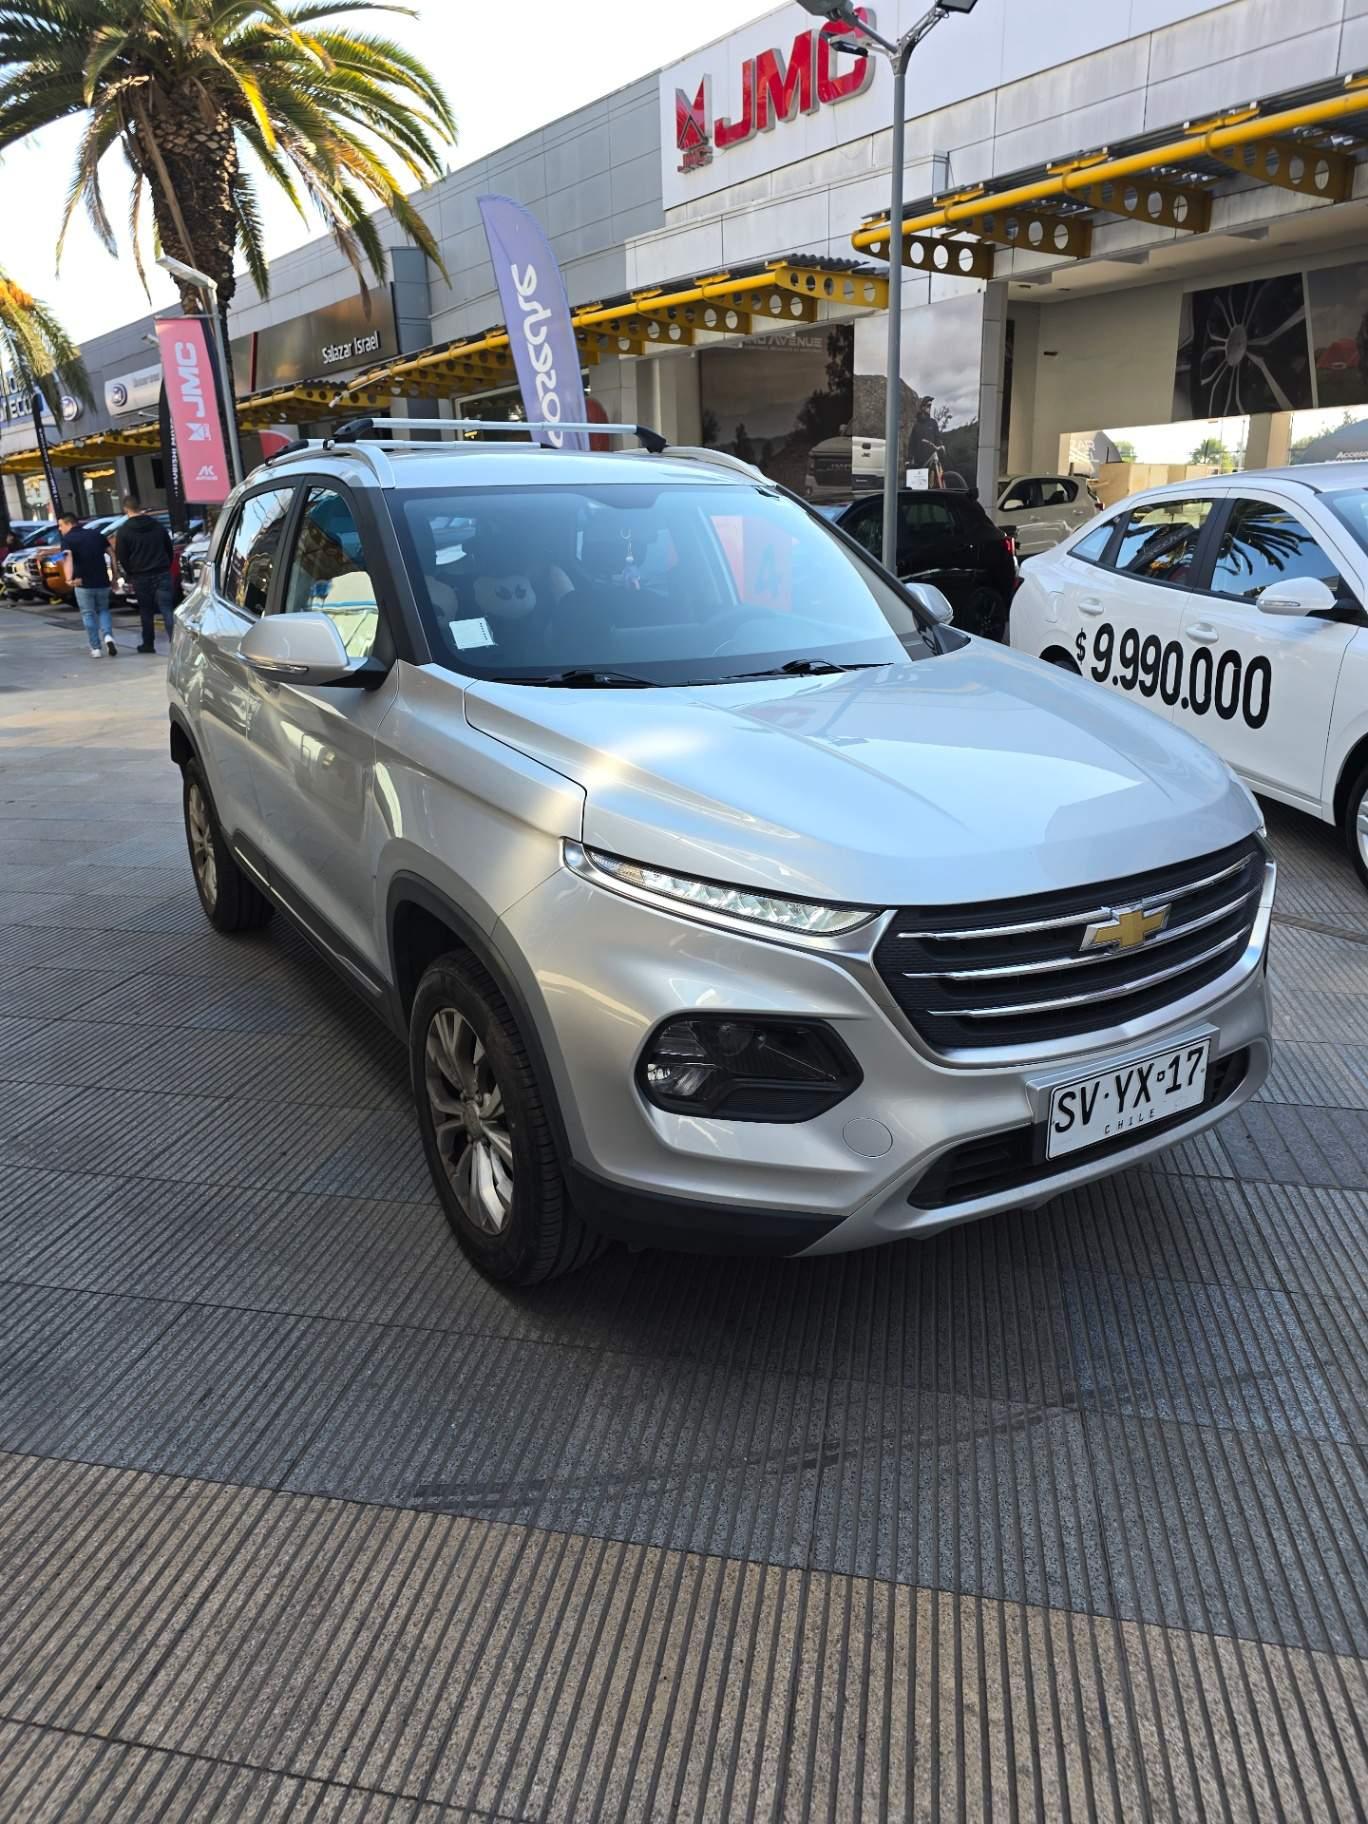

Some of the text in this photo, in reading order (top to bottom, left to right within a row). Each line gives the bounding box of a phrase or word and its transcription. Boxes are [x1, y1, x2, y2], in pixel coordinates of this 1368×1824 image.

[715, 7, 874, 149] JMC
[321, 330, 379, 364] Salazar Israel
[175, 341, 207, 417] JMC
[1104, 1109, 1156, 1134] CHILE
